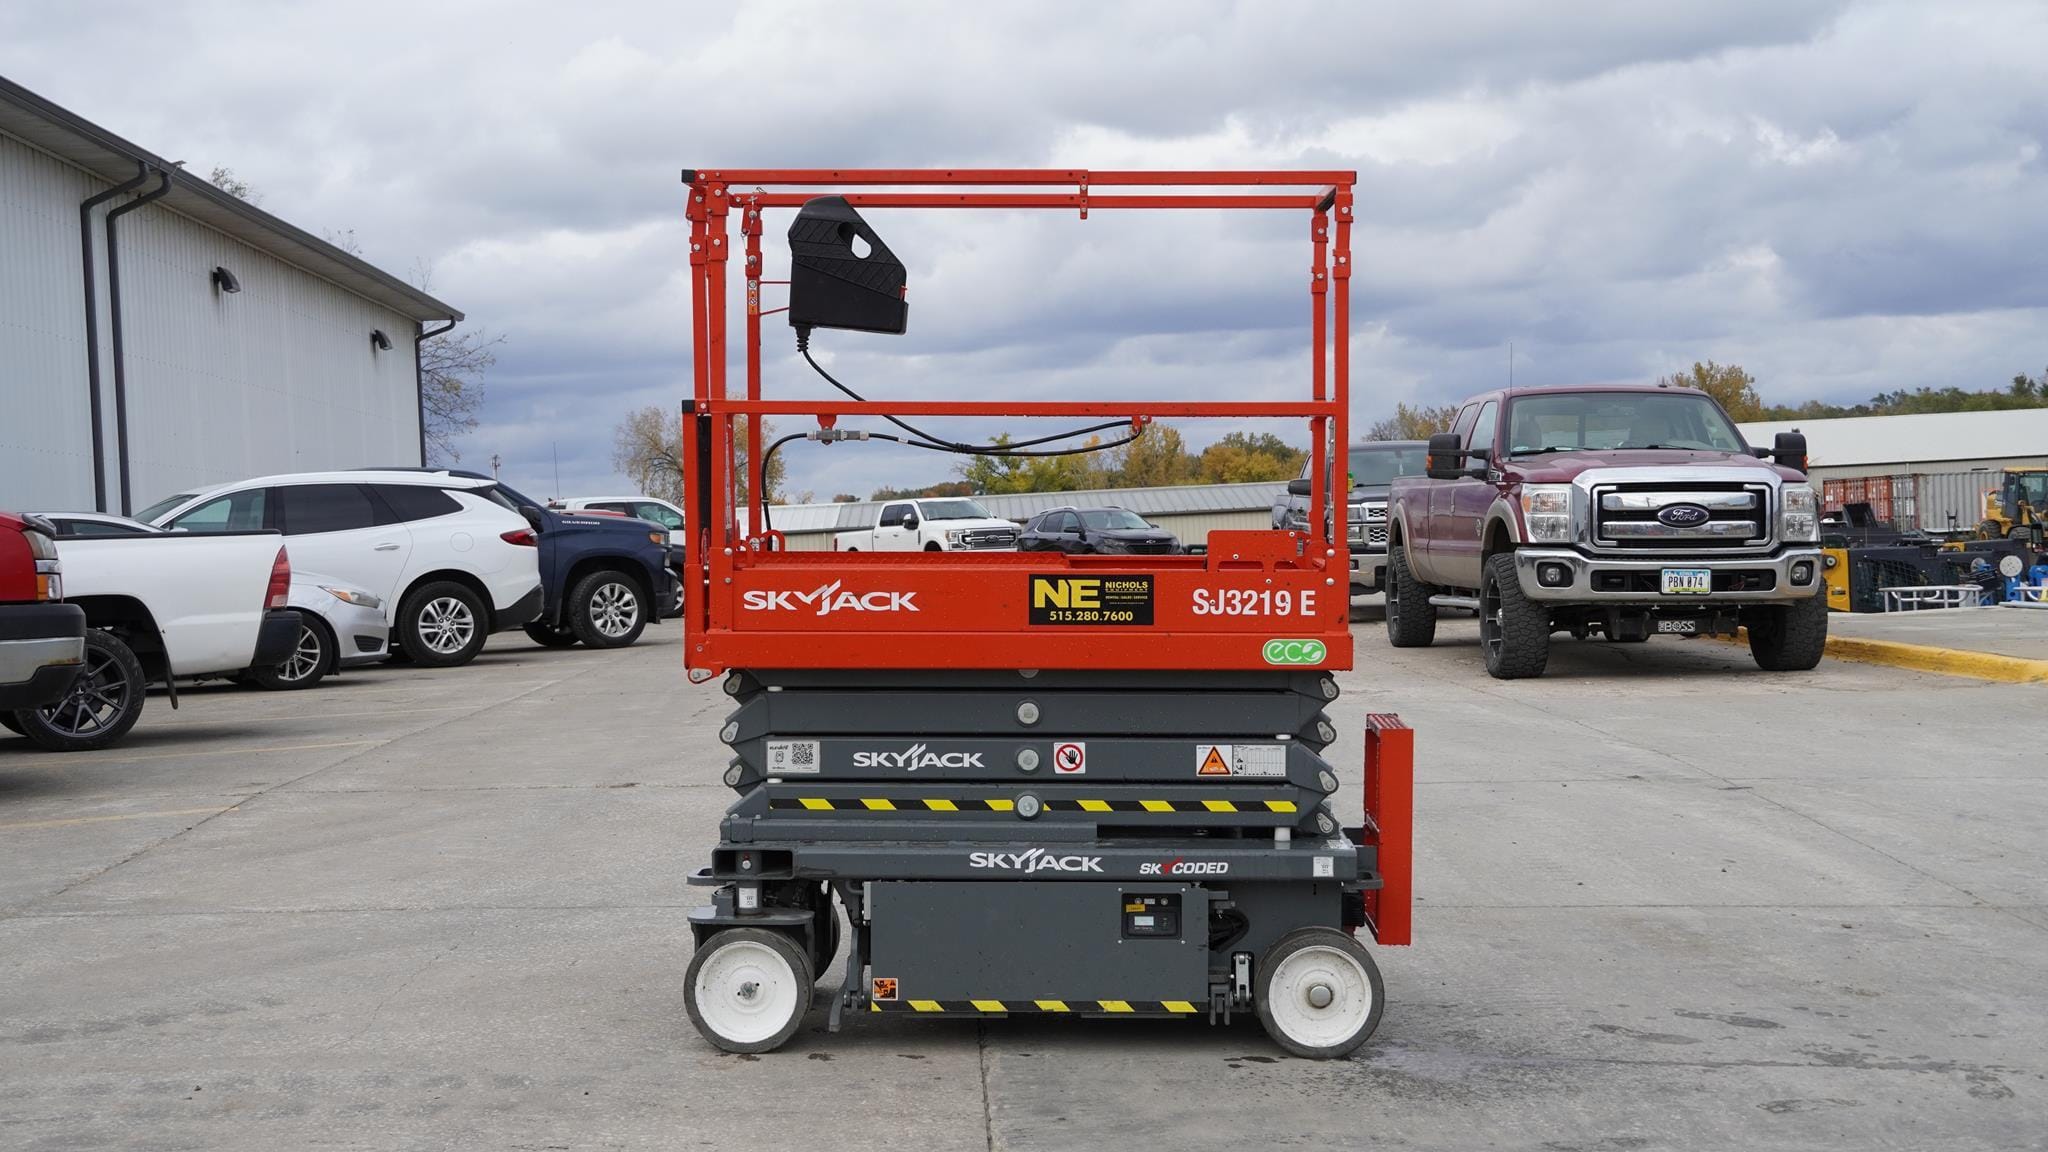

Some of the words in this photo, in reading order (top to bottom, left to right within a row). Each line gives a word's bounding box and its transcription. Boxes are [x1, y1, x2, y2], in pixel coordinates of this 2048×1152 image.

[1670, 509, 1698, 521] Ford
[1105, 581, 1148, 589] NICHOLS
[1668, 576, 1684, 588] PBN
[1687, 576, 1703, 588] 074
[743, 579, 921, 616] SKYJACK
[1034, 579, 1101, 608] NE
[1192, 588, 1292, 616] SJ3219
[1300, 590, 1316, 616] E
[1049, 611, 1133, 621] 515.280.7600
[1664, 621, 1695, 632] BOSS
[1267, 642, 1323, 662] eco
[853, 743, 985, 771] SKYJACK
[969, 848, 1104, 873] SKYJACK
[1139, 856, 1229, 875] SKYCODED
